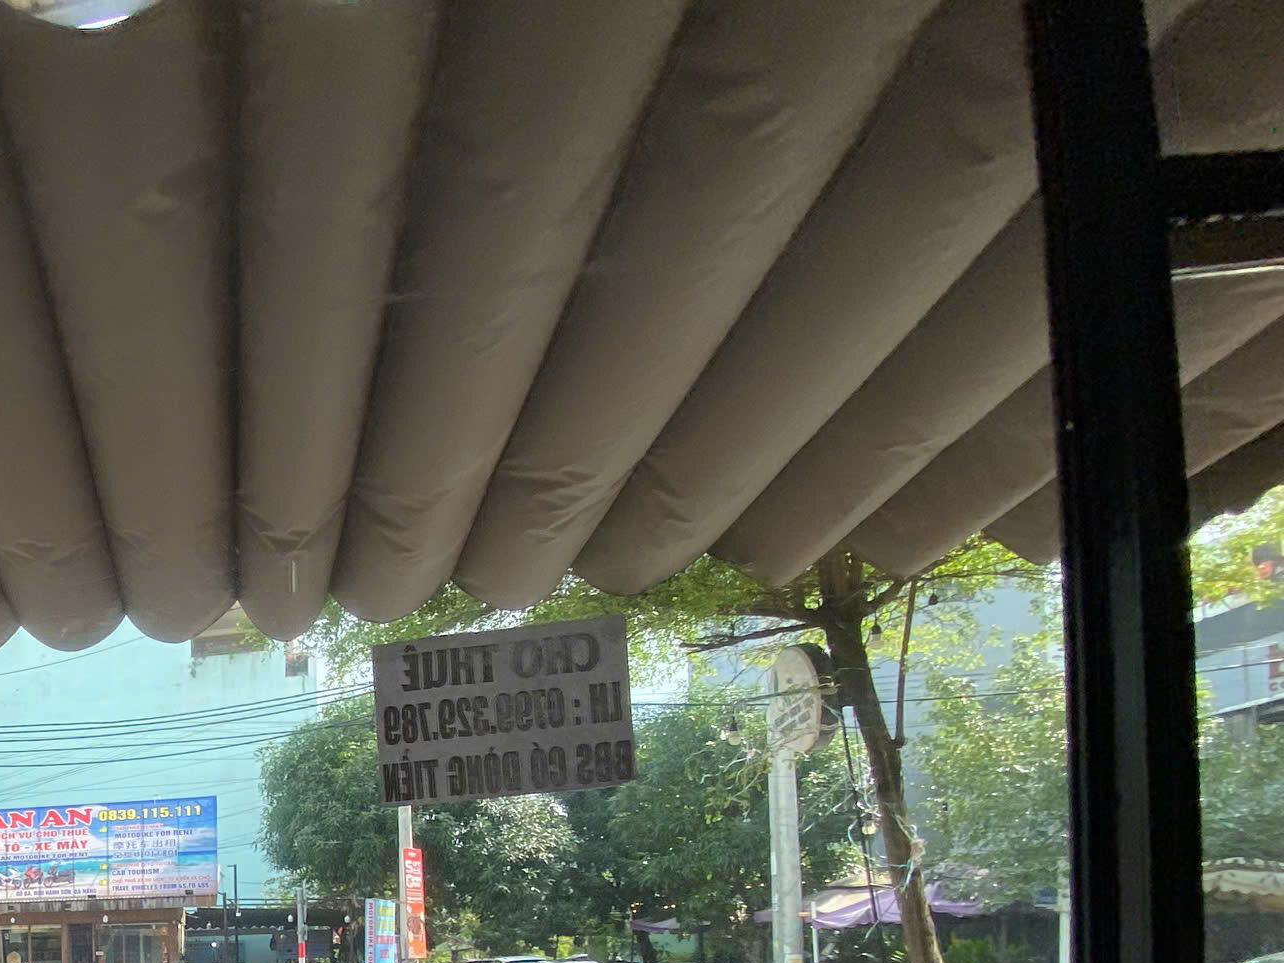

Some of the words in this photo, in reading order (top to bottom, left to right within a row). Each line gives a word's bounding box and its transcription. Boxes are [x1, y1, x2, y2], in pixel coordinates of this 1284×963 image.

[39, 808, 93, 828] AN
[99, 804, 201, 821] 0839.115.111
[36, 830, 57, 838] CHO
[35, 842, 52, 851] XE
